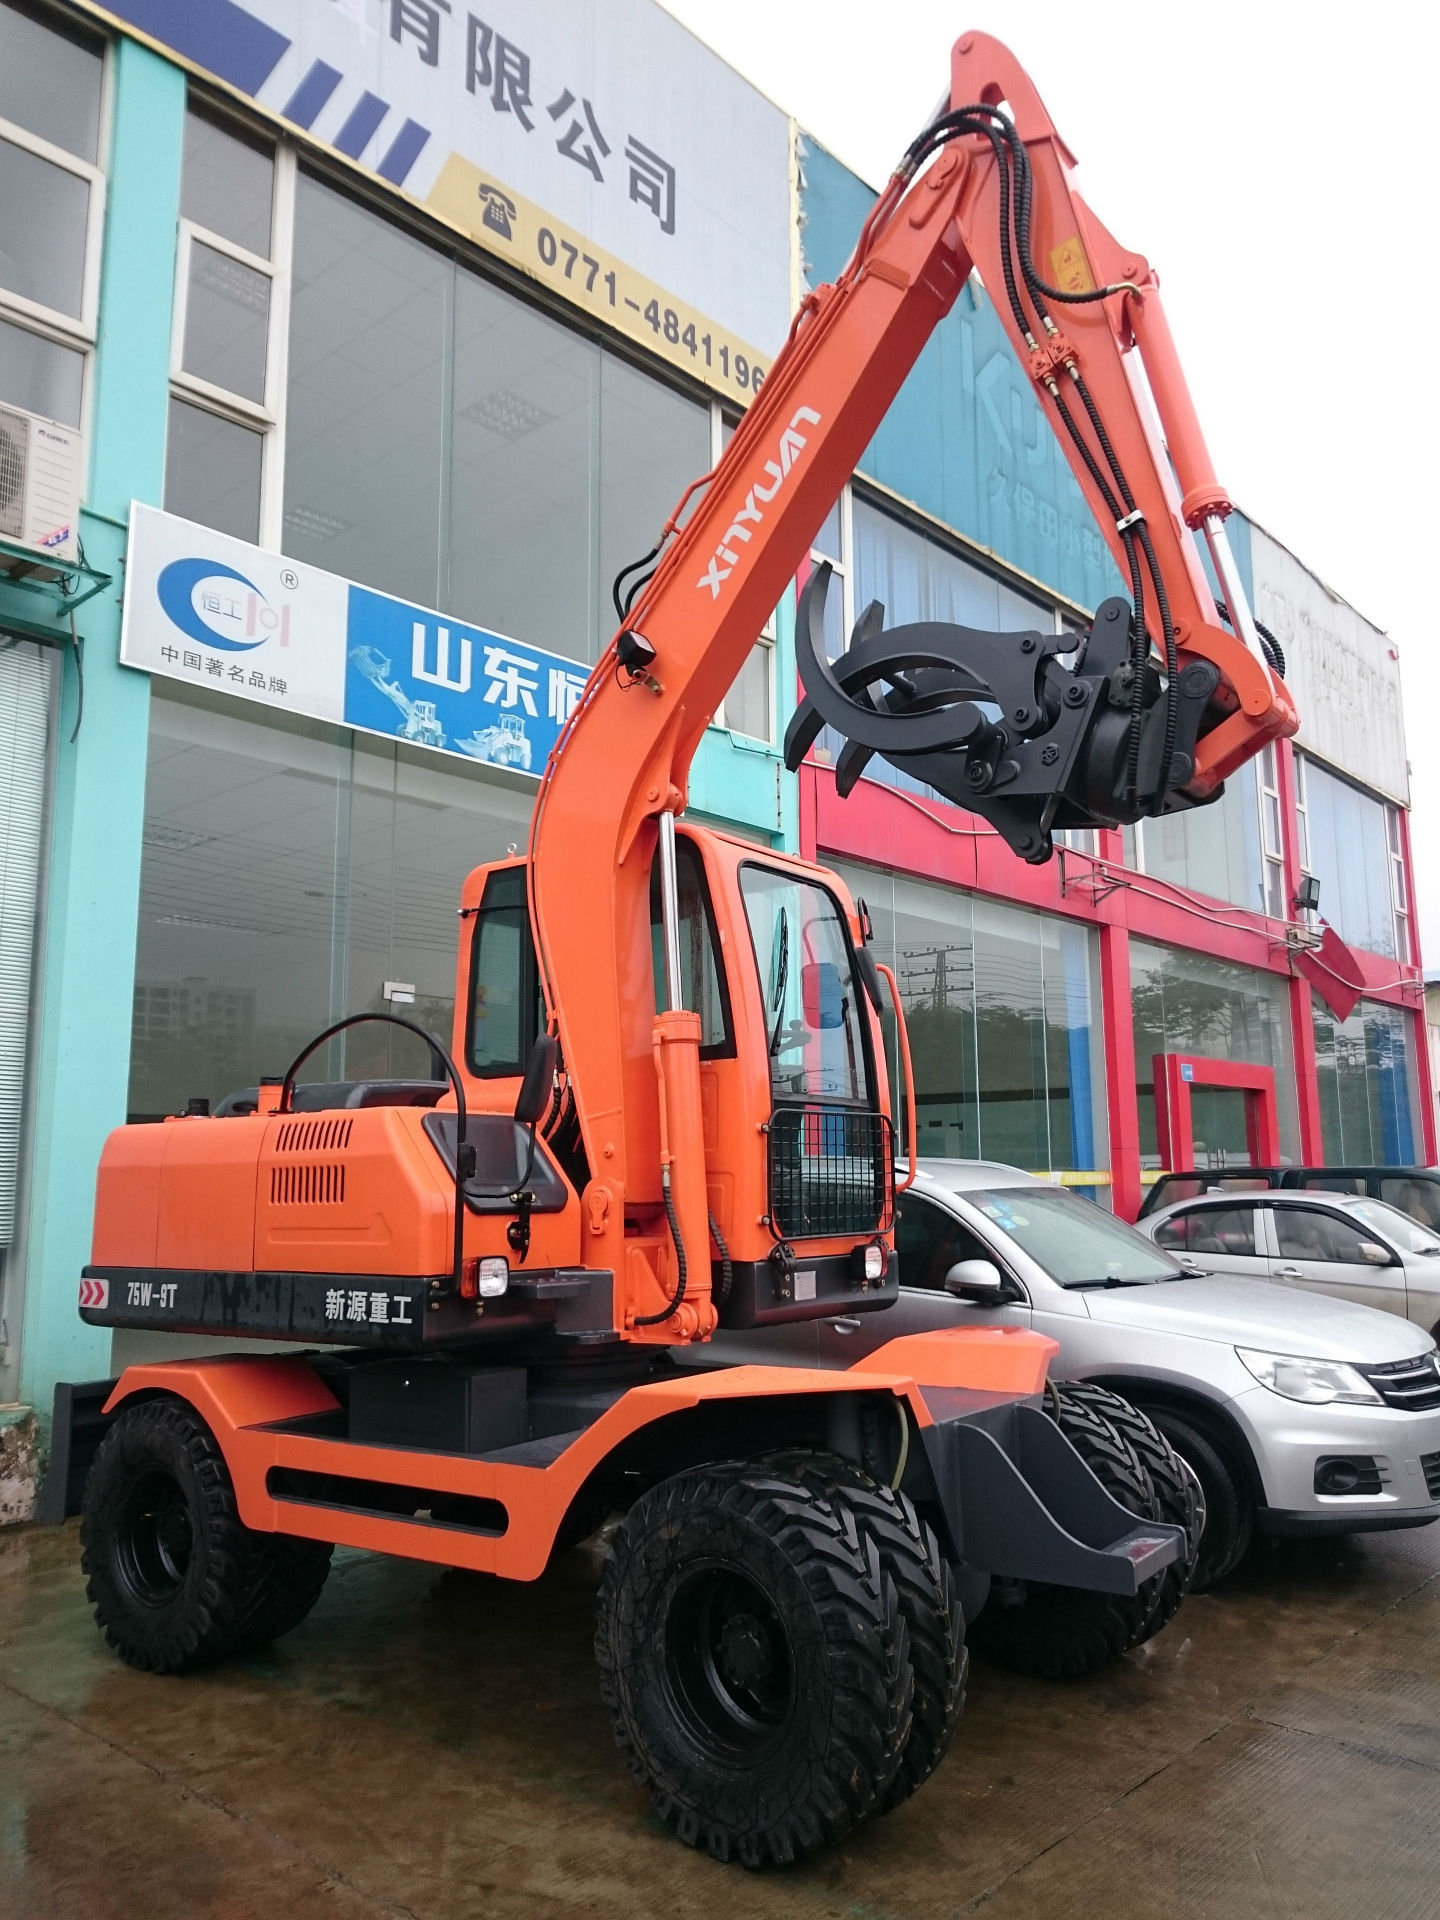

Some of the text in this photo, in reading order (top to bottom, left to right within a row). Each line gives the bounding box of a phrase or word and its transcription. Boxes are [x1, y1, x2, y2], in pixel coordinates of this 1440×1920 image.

[537, 228, 766, 395] 0771-4841196
[160, 645, 288, 696] 中国著名品牌
[127, 1281, 178, 1309] 75W-9T
[325, 1288, 413, 1324] 新源重工
